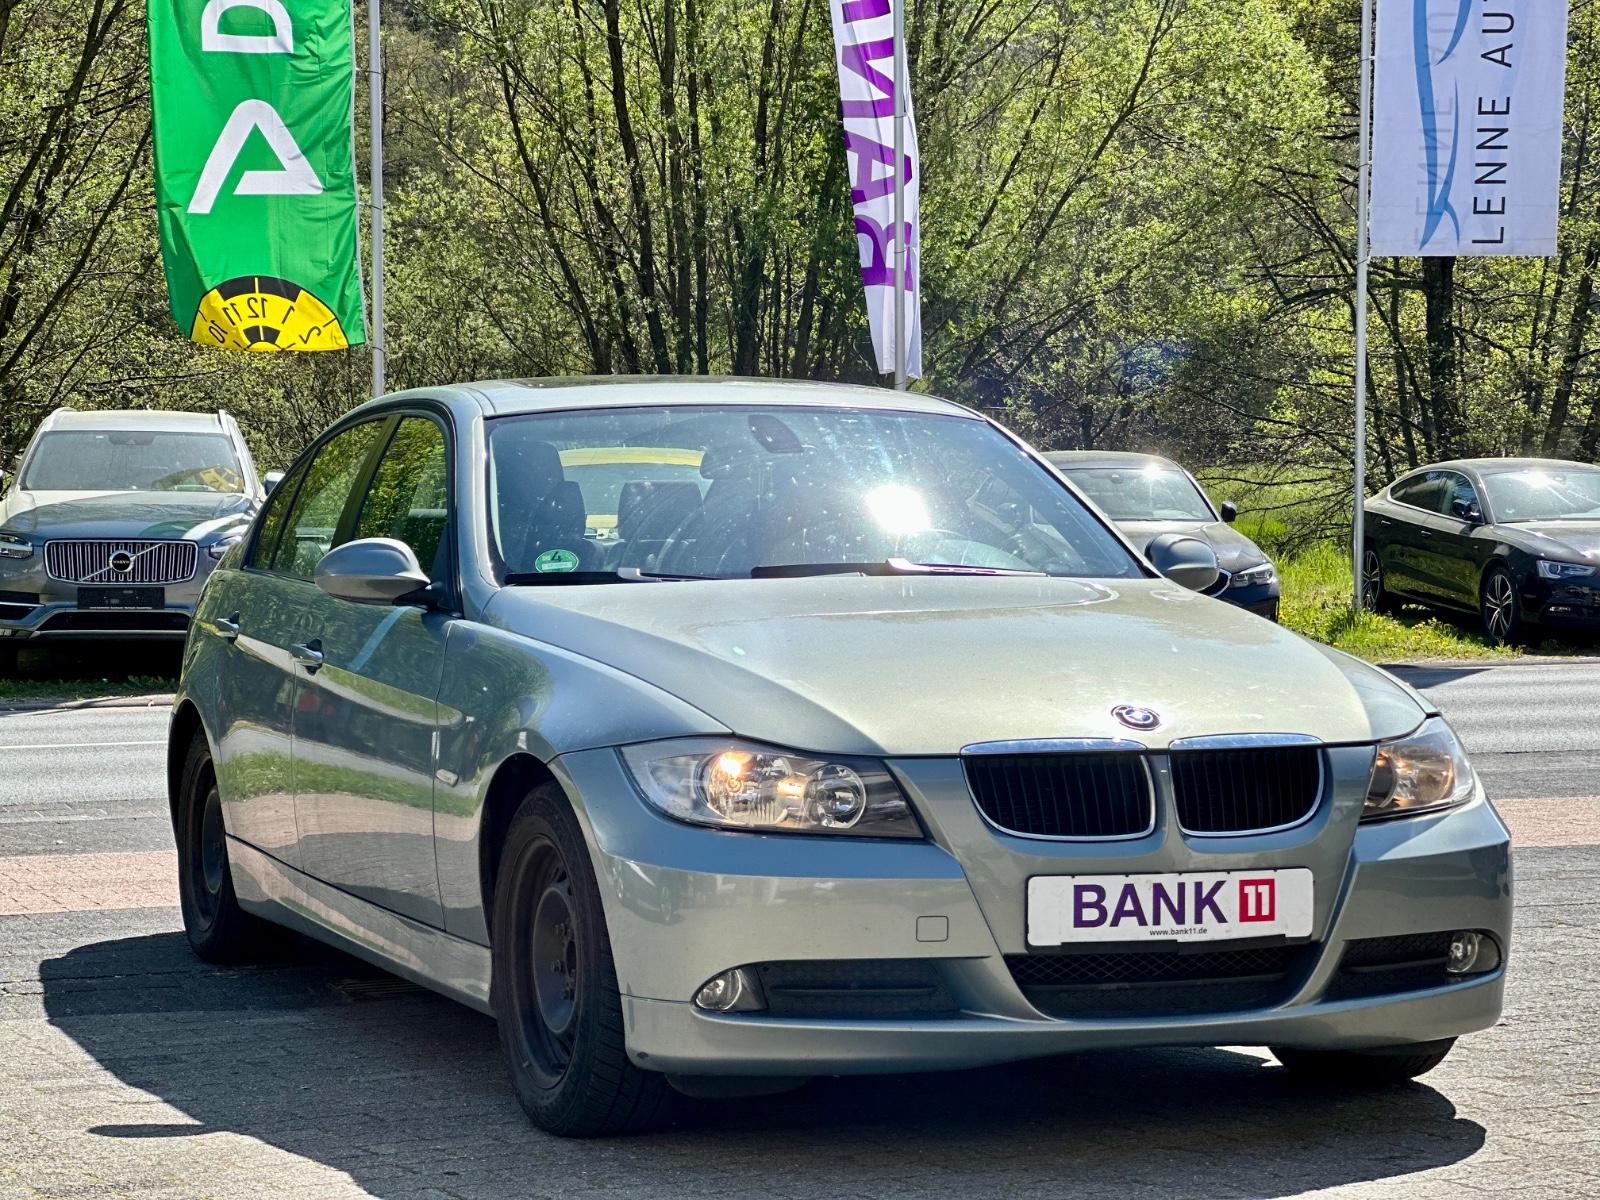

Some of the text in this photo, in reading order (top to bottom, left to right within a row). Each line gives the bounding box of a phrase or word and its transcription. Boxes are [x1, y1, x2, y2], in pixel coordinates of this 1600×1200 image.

[1472, 0, 1515, 244] LENNE AU
[1072, 880, 1272, 929] BANK 11
[1149, 927, 1208, 936] www.bank11.de
